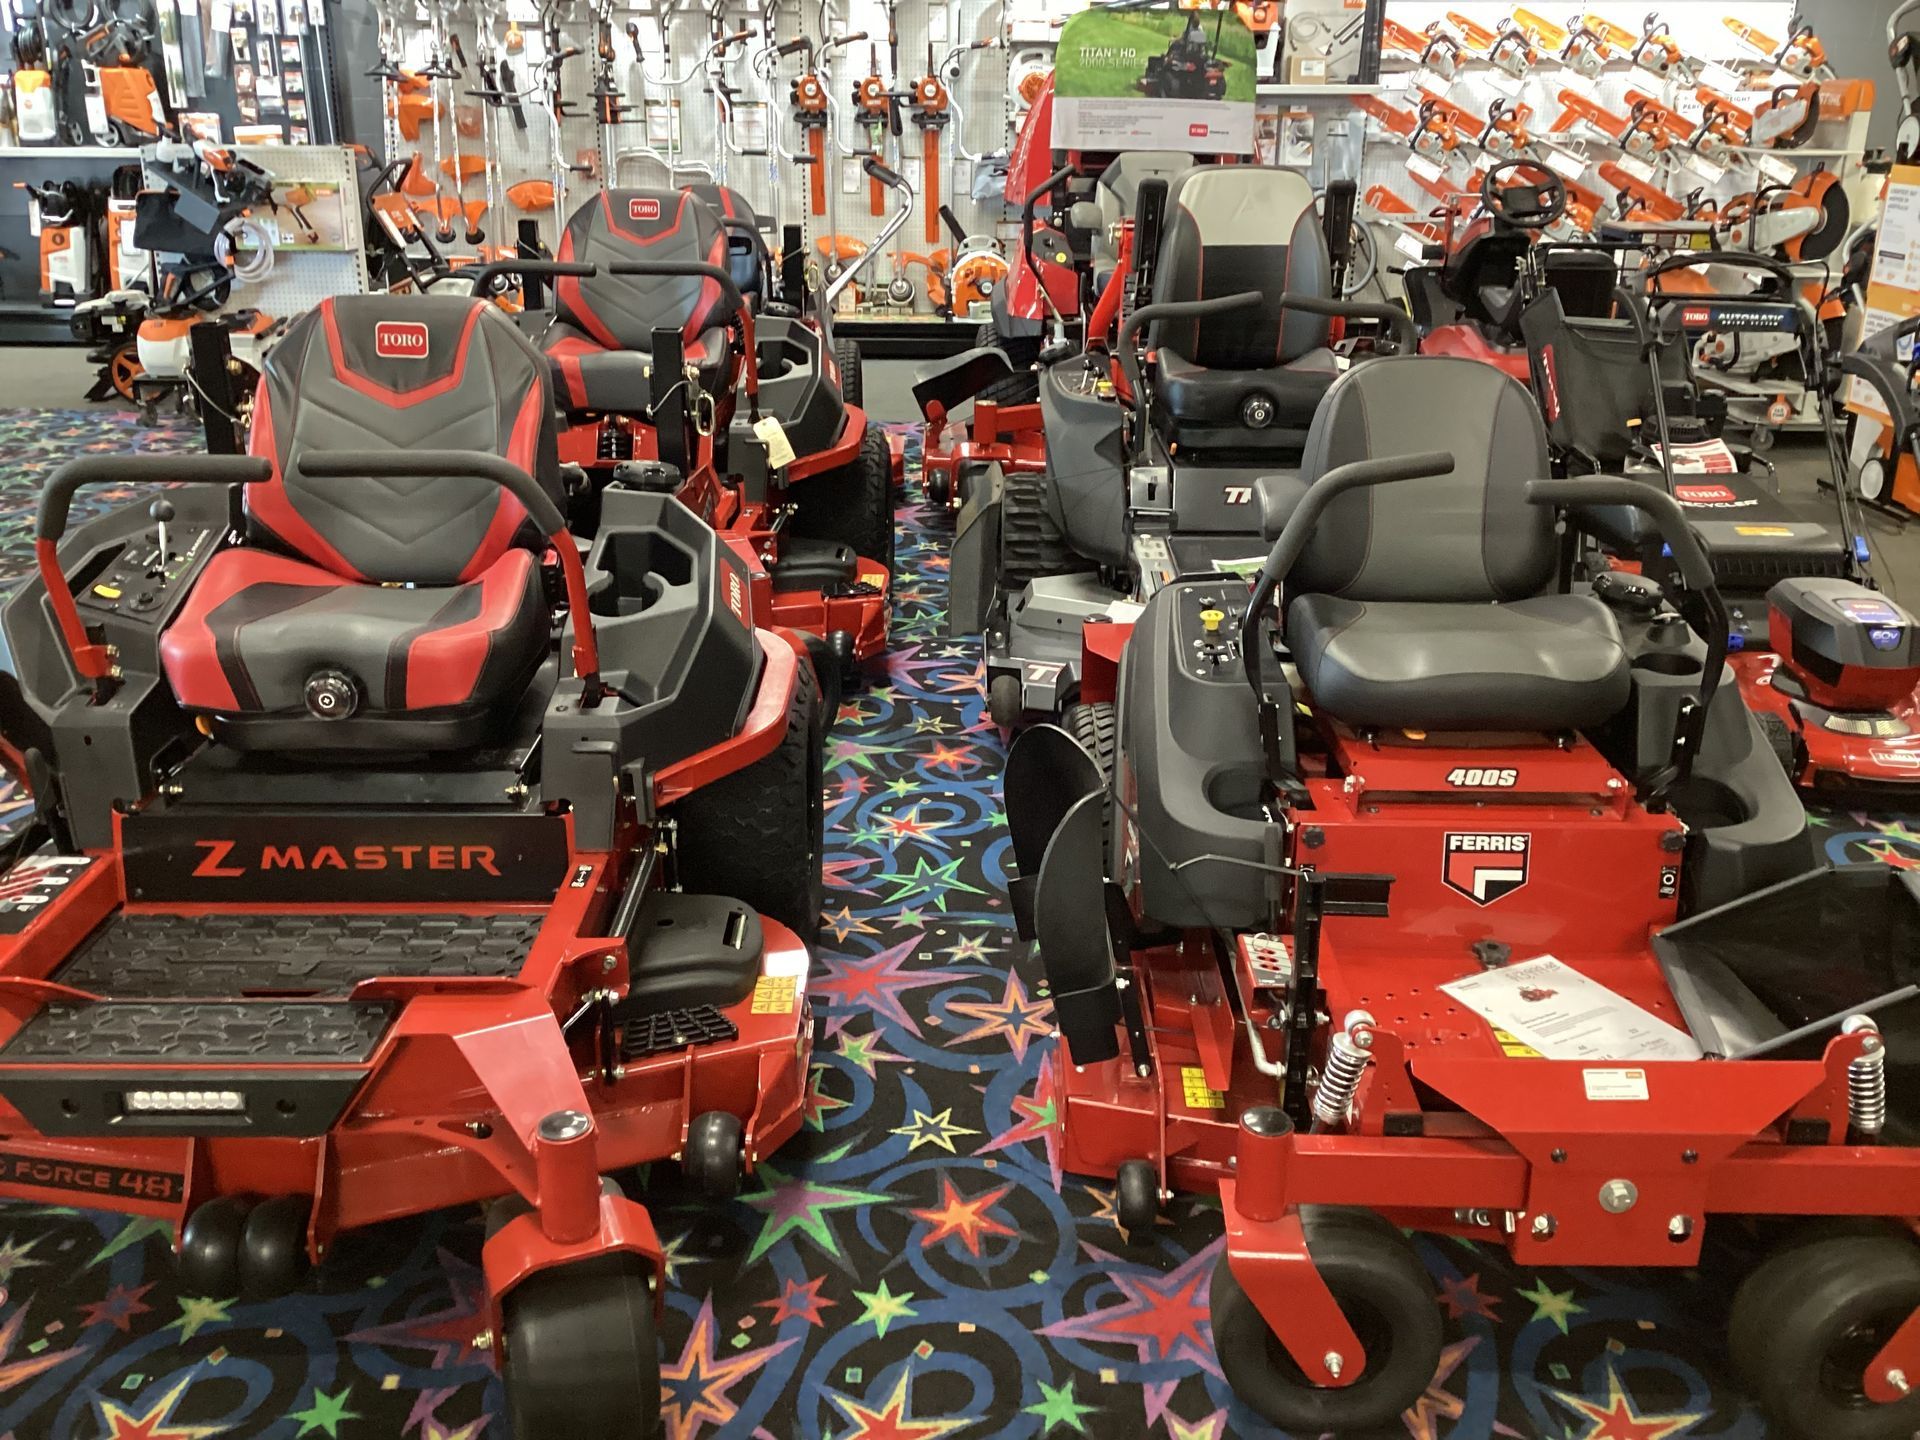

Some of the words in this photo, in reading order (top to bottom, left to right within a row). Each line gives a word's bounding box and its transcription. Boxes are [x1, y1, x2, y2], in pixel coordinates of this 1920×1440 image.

[1080, 47, 1112, 58] TITAN
[1120, 47, 1136, 58] HD
[631, 205, 657, 214] TORO
[1684, 312, 1709, 321] TORO
[1718, 312, 1785, 322] AUTOMATIC
[380, 333, 424, 348] TORO
[1681, 489, 1728, 498] TORO
[729, 572, 742, 618] TORO
[1447, 768, 1518, 787] 400S
[1449, 835, 1527, 851] FERRIS
[191, 840, 246, 877] Z
[260, 845, 502, 876] MASTER
[15, 1161, 112, 1189] FORCE
[118, 1172, 173, 1199] 48
